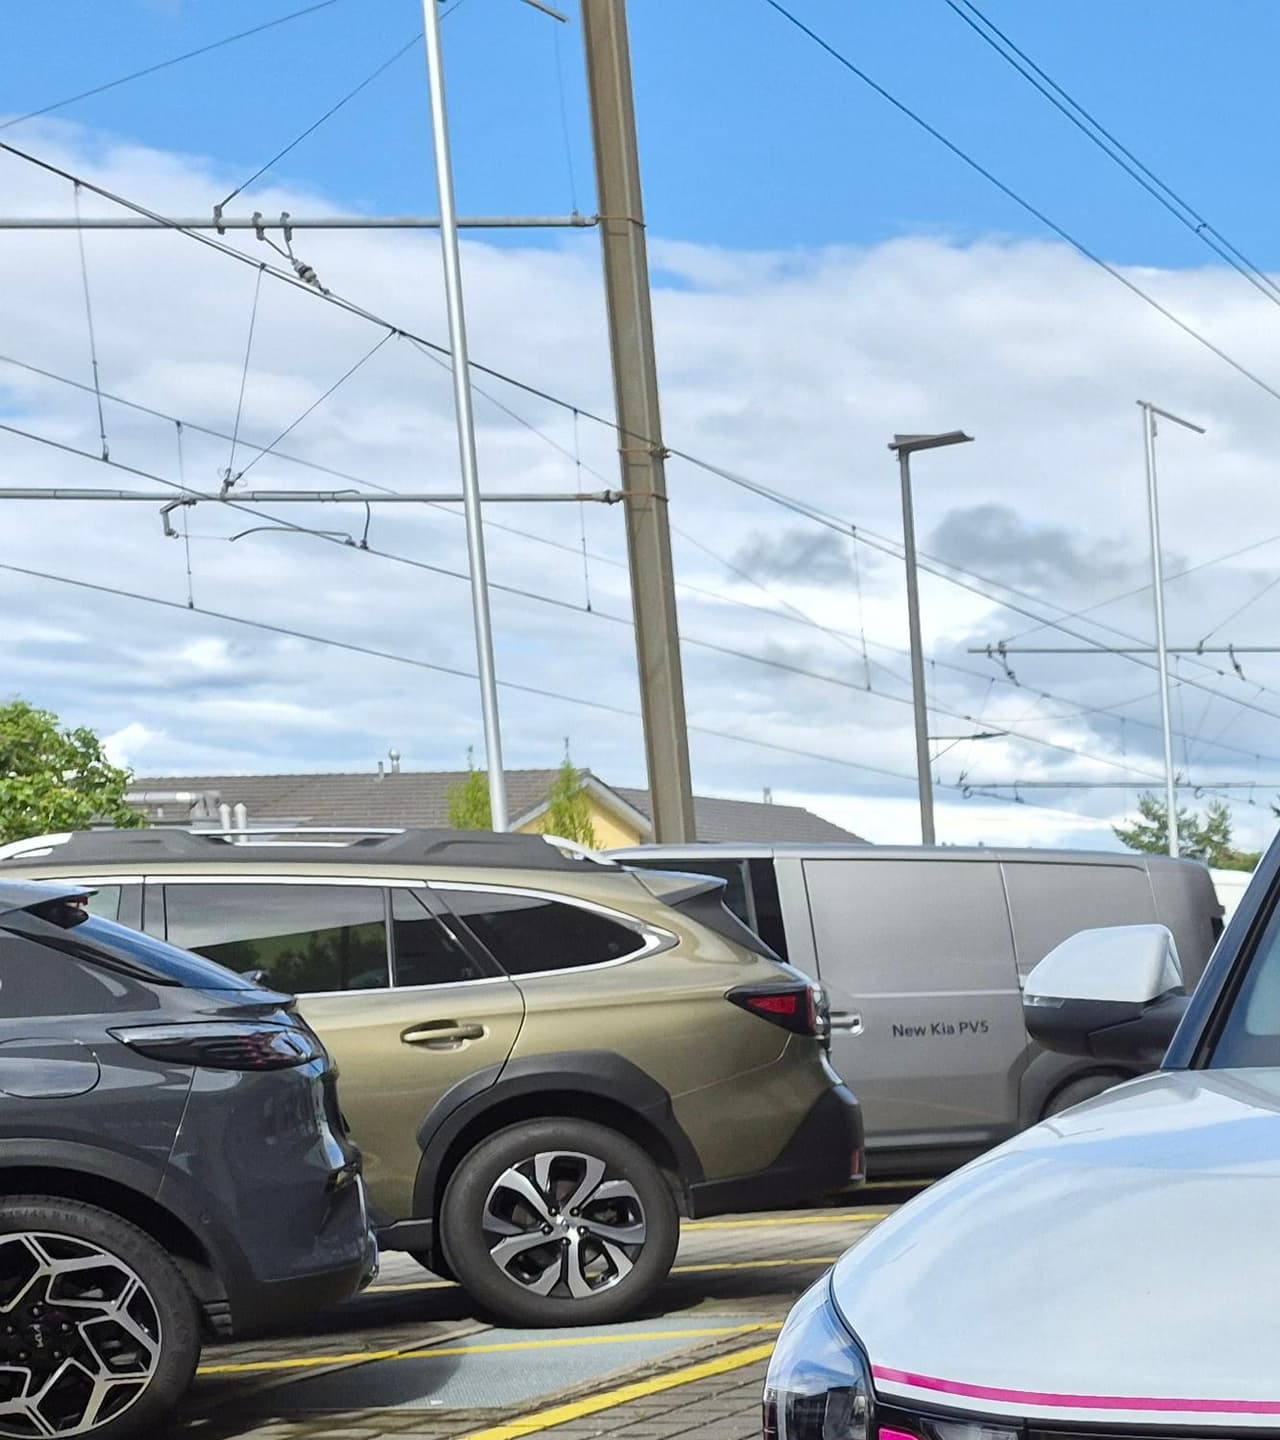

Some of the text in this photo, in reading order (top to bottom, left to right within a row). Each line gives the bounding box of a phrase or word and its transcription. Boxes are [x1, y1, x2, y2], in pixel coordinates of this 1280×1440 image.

[892, 1019, 990, 1038] New Kia PV5
